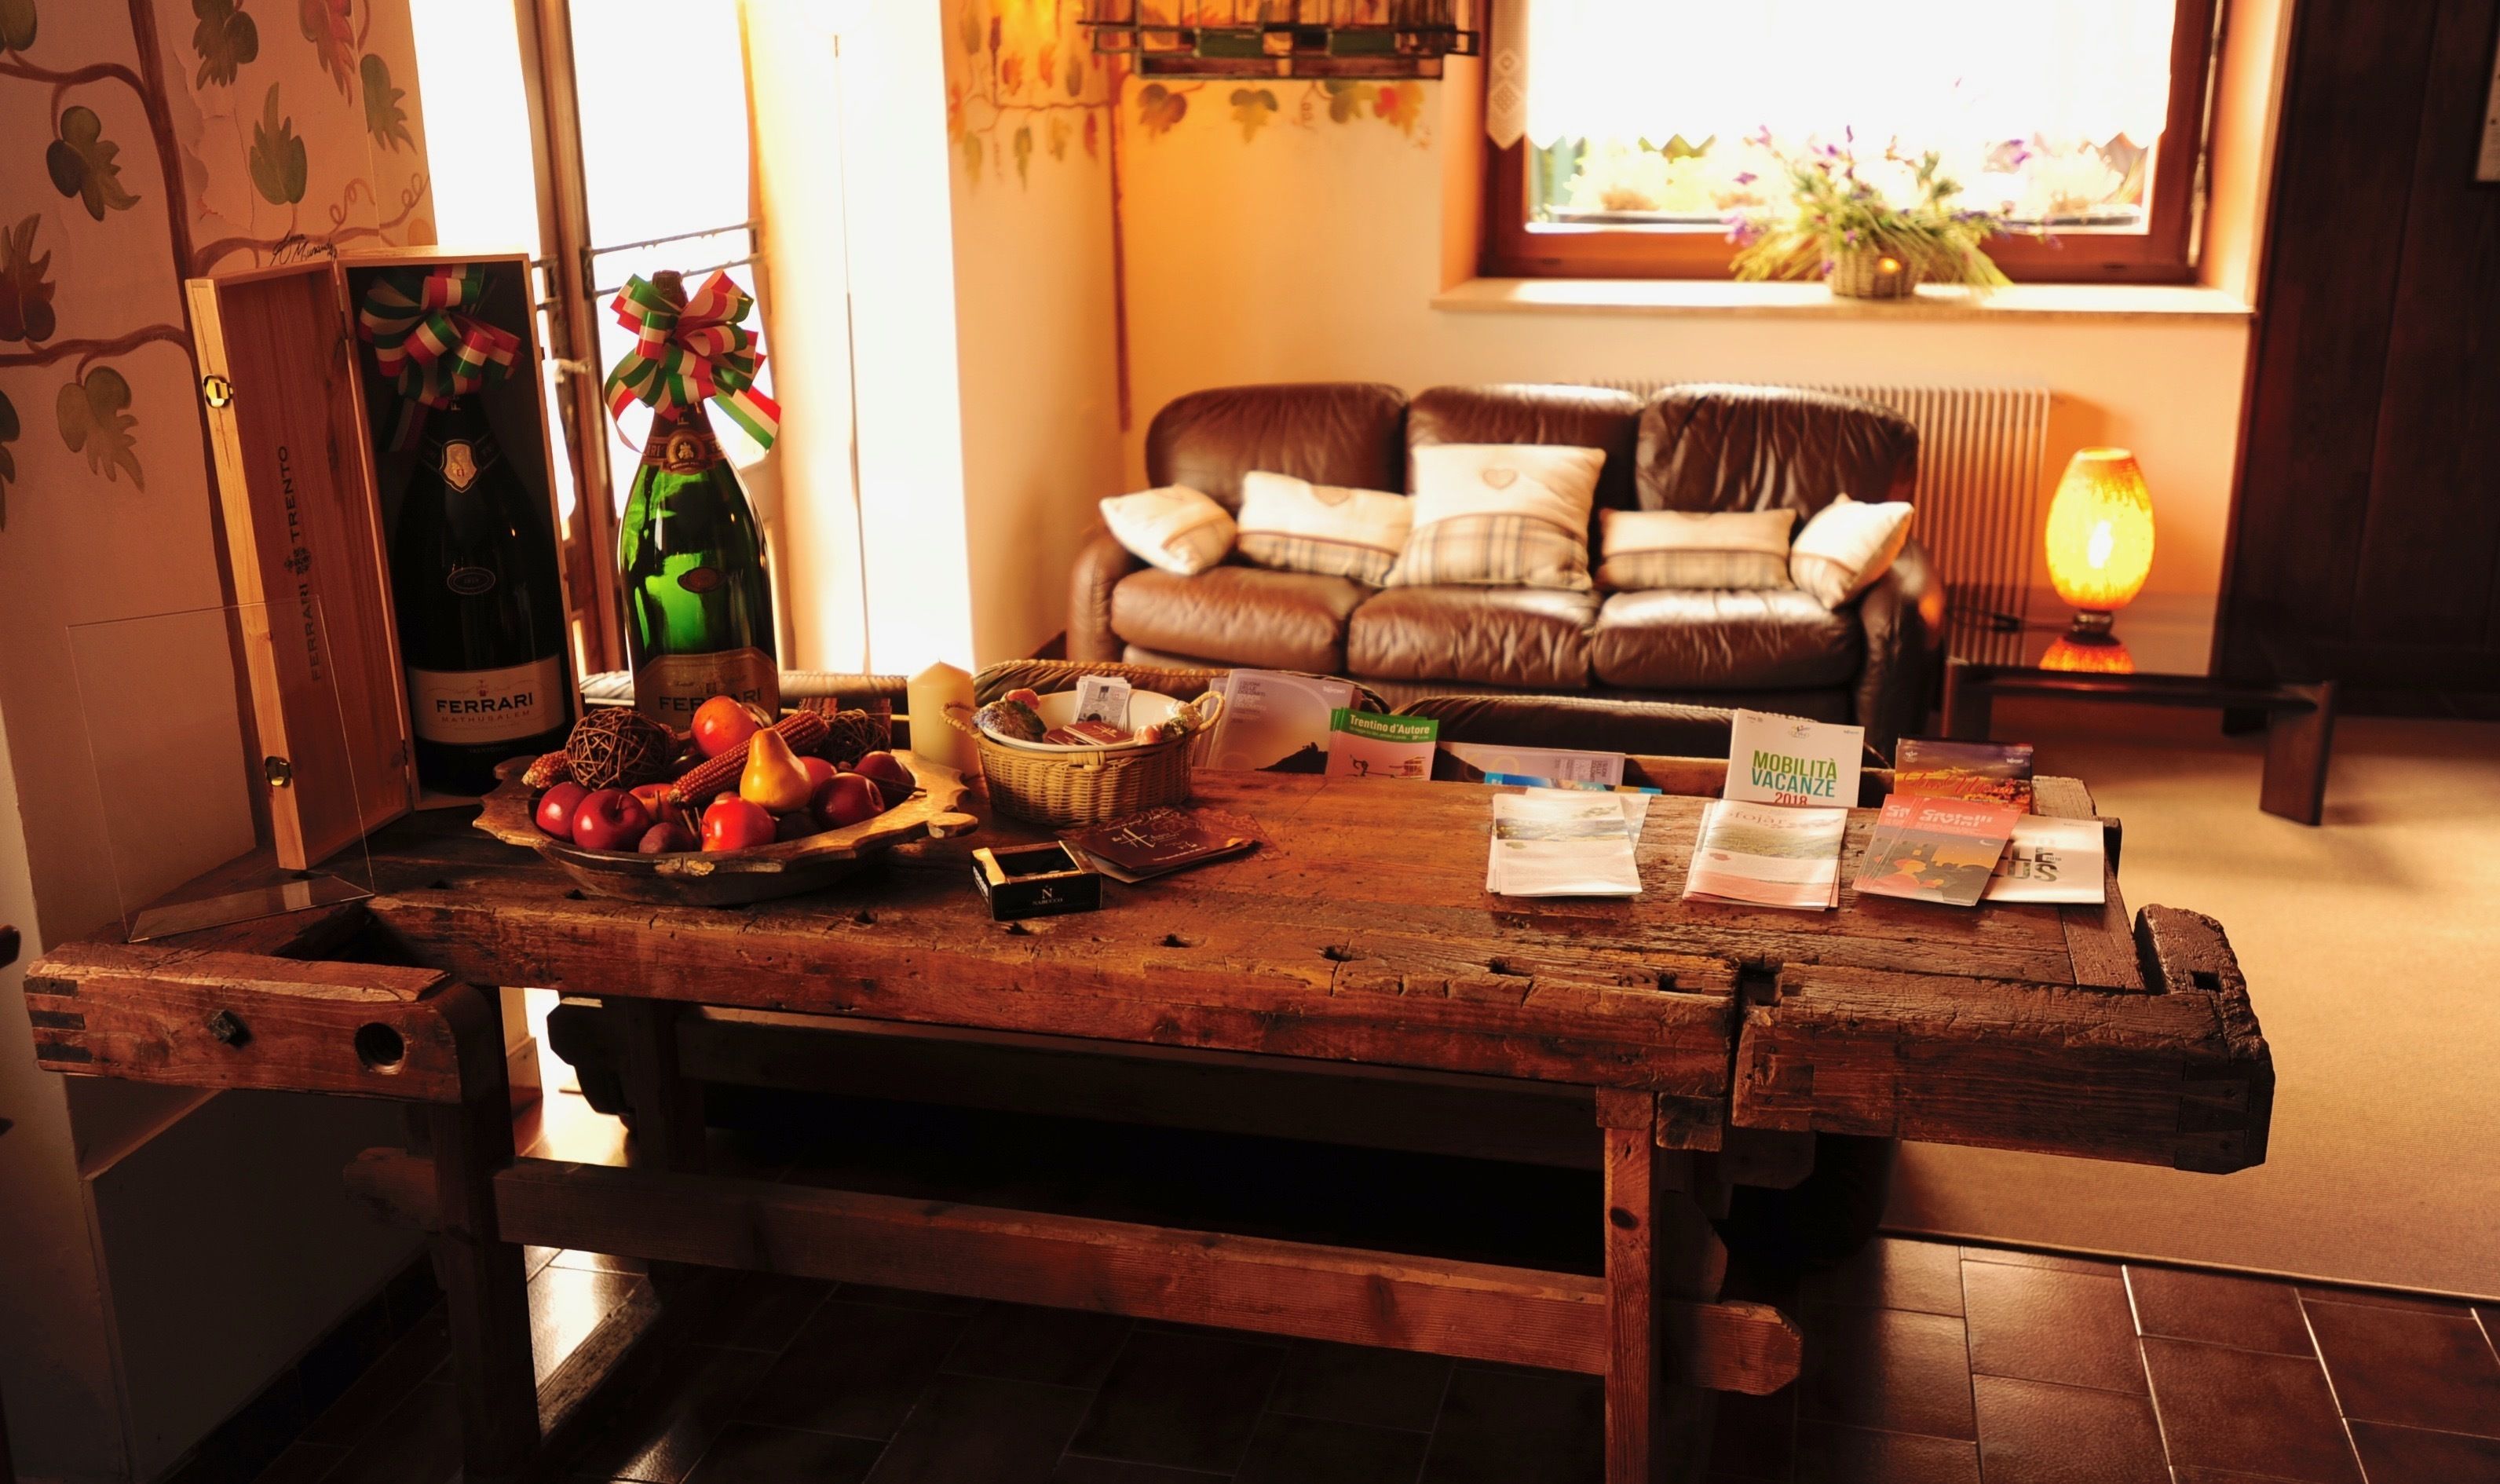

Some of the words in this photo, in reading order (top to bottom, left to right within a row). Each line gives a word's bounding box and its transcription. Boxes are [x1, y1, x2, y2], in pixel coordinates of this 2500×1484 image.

[278, 445, 301, 543] TRENTO
[298, 584, 320, 682] FERRARI
[436, 693, 534, 714] FERRARI
[441, 709, 530, 723] MATHUSALEM
[1350, 715, 1388, 732] Trentino
[1389, 723, 1431, 735] d'Autore
[1753, 750, 1837, 780] MOBILITÀ
[1752, 767, 1837, 798] VACANZE
[1774, 791, 1808, 806] 2018
